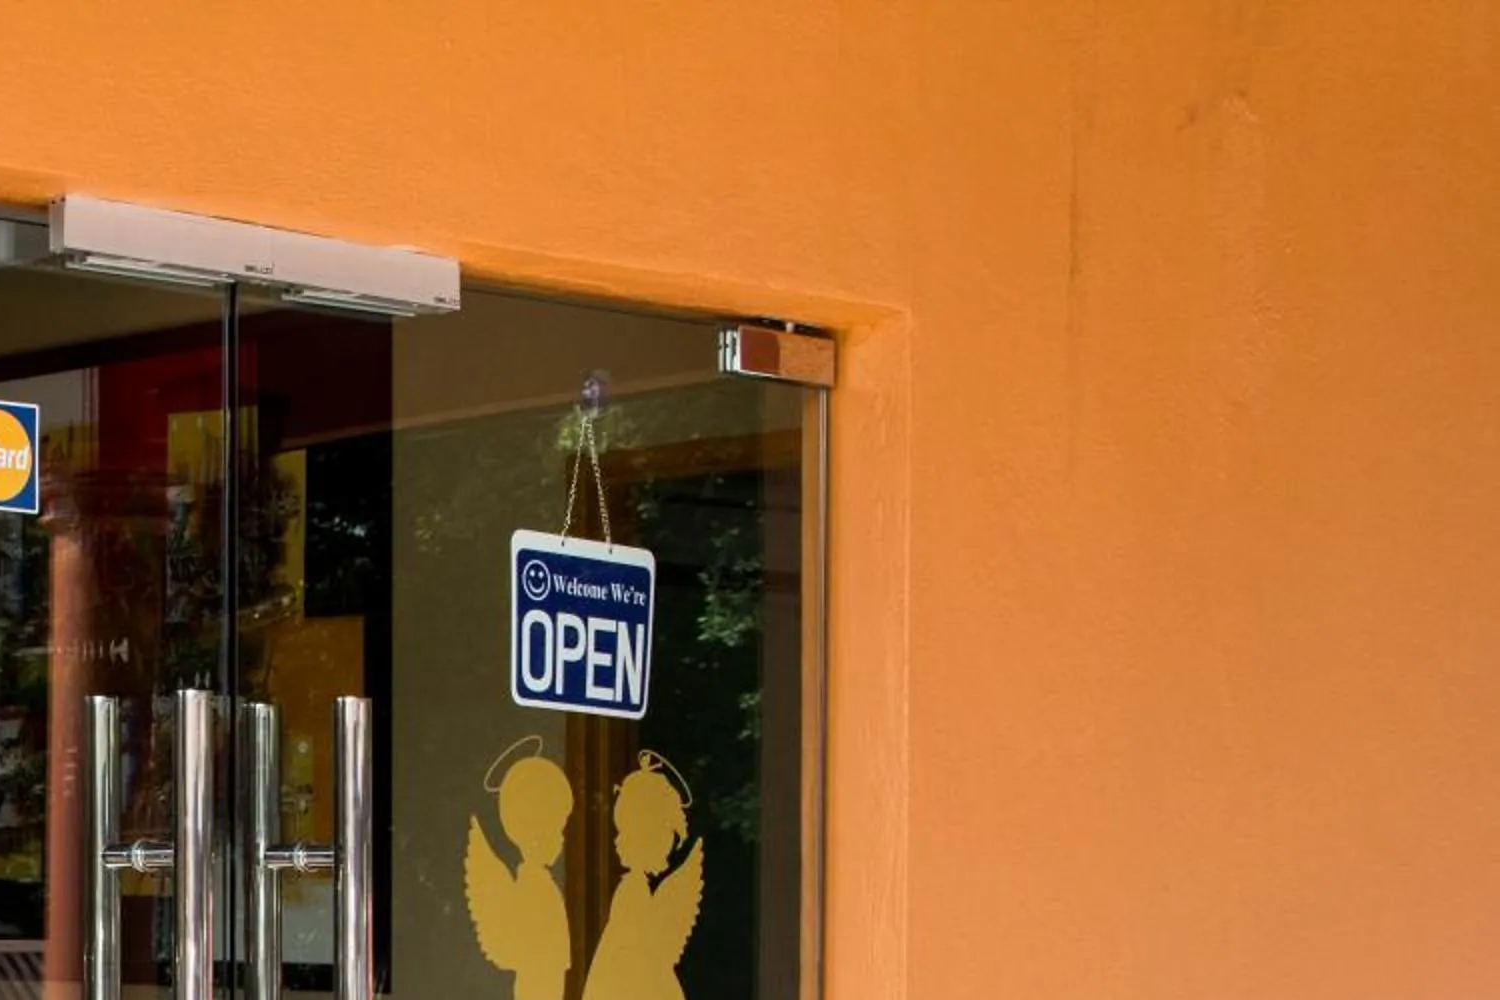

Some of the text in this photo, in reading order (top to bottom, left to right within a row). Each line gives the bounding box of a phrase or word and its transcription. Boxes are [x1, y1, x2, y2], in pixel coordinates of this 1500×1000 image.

[552, 573, 647, 607] Welcome We're
[520, 608, 645, 705] OPEN
